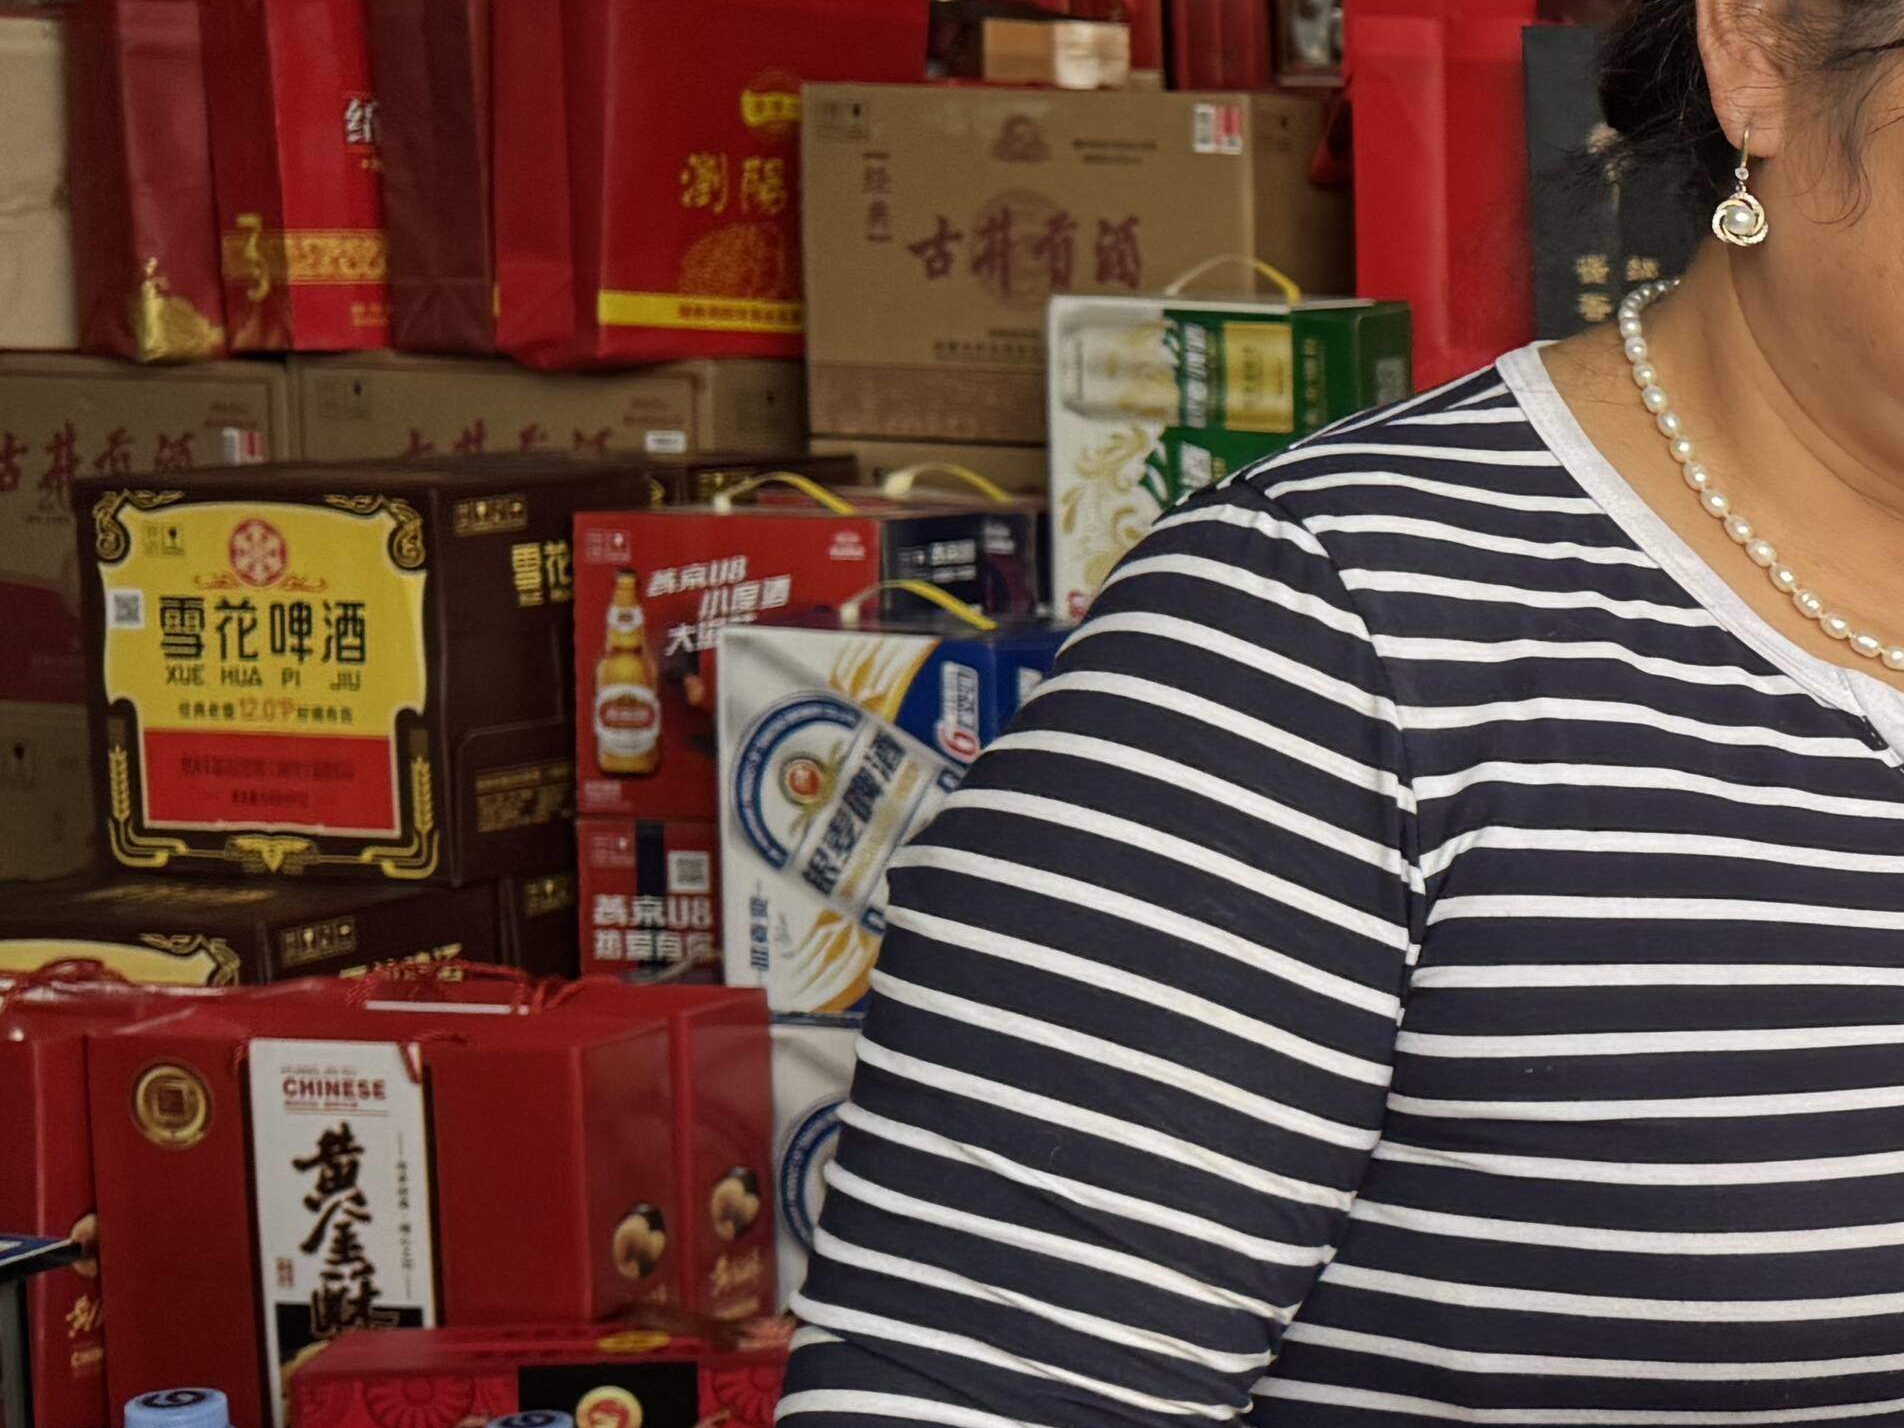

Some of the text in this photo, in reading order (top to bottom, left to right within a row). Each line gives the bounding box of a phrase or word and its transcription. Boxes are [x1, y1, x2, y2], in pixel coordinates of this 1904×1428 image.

[155, 596, 367, 670] 雪花啤酒
[166, 667, 206, 689] XUE
[220, 668, 263, 690] HUA
[282, 670, 300, 690] PI
[281, 1078, 388, 1102] CHINESE
